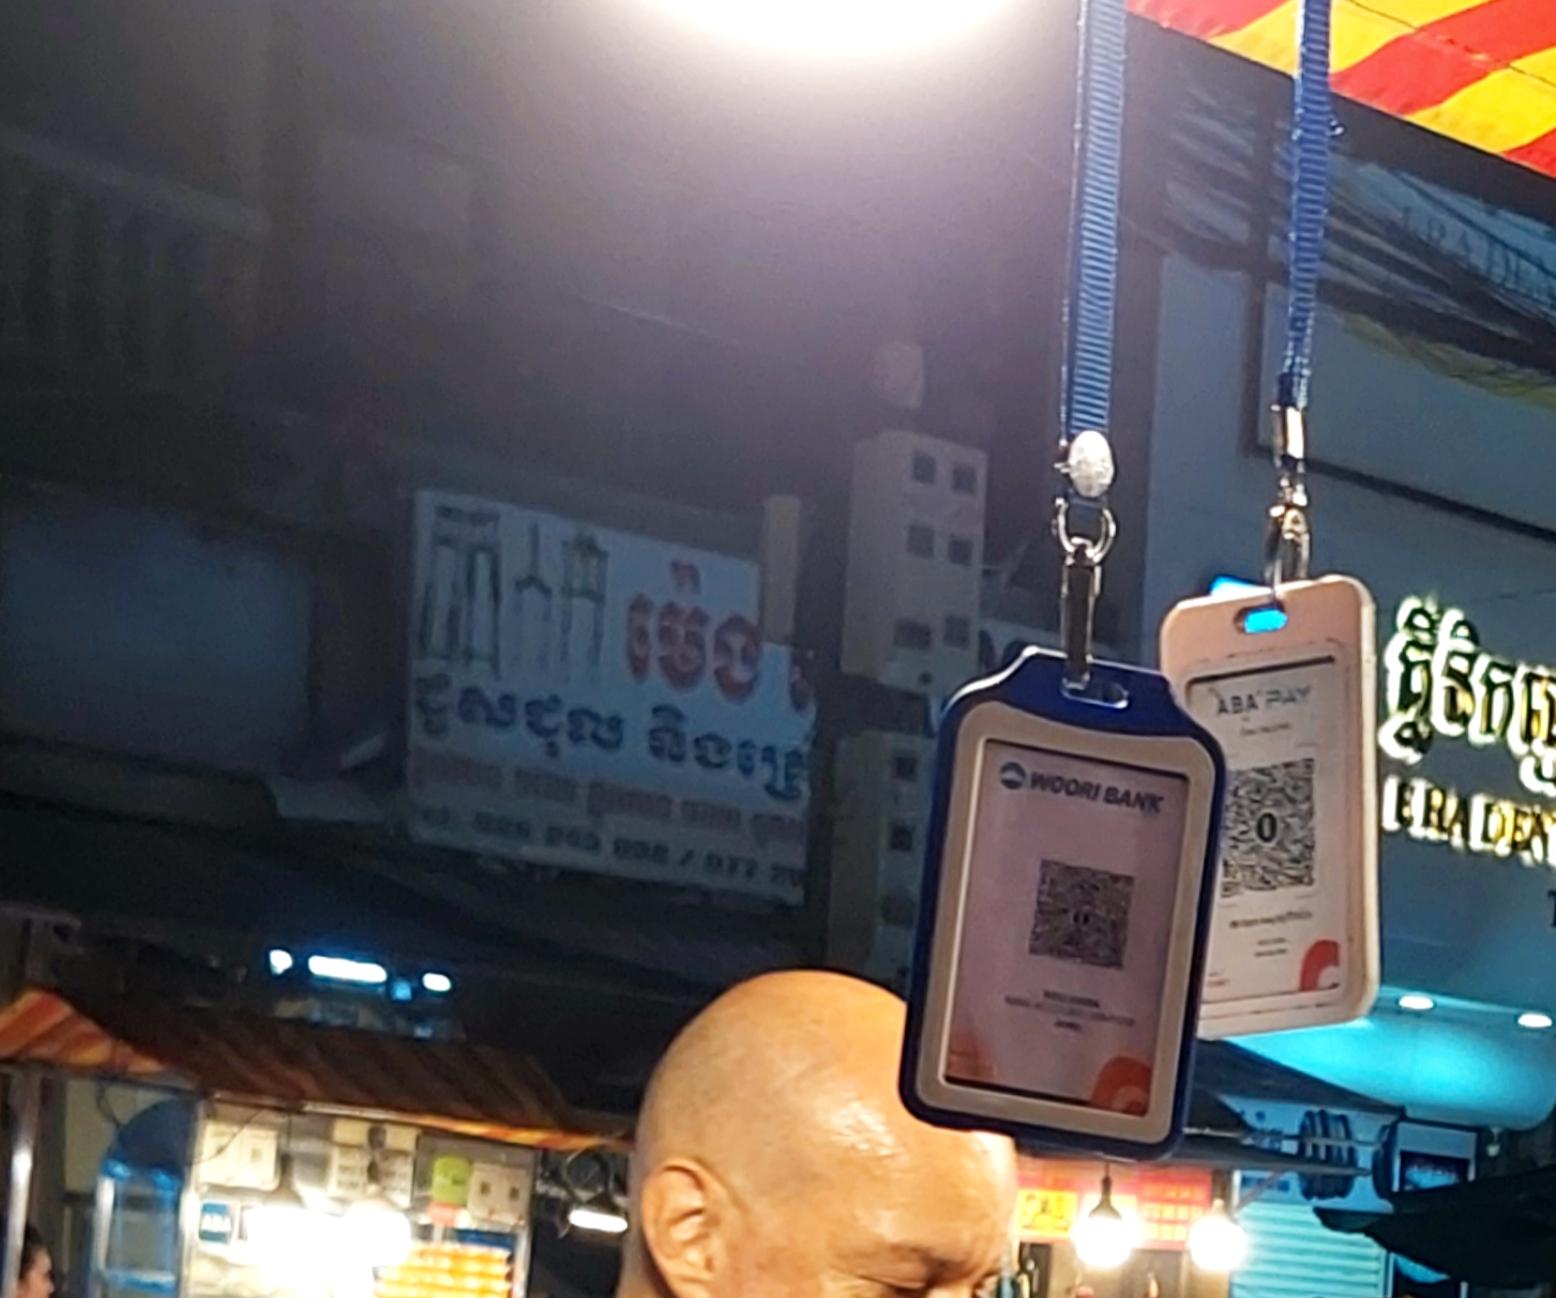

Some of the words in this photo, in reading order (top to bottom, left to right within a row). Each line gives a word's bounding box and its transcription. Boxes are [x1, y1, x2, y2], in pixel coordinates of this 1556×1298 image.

[1216, 692, 1259, 715] ABA
[1264, 685, 1312, 709] PAY
[1029, 771, 1101, 801] WOORI
[1103, 785, 1165, 813] BANK
